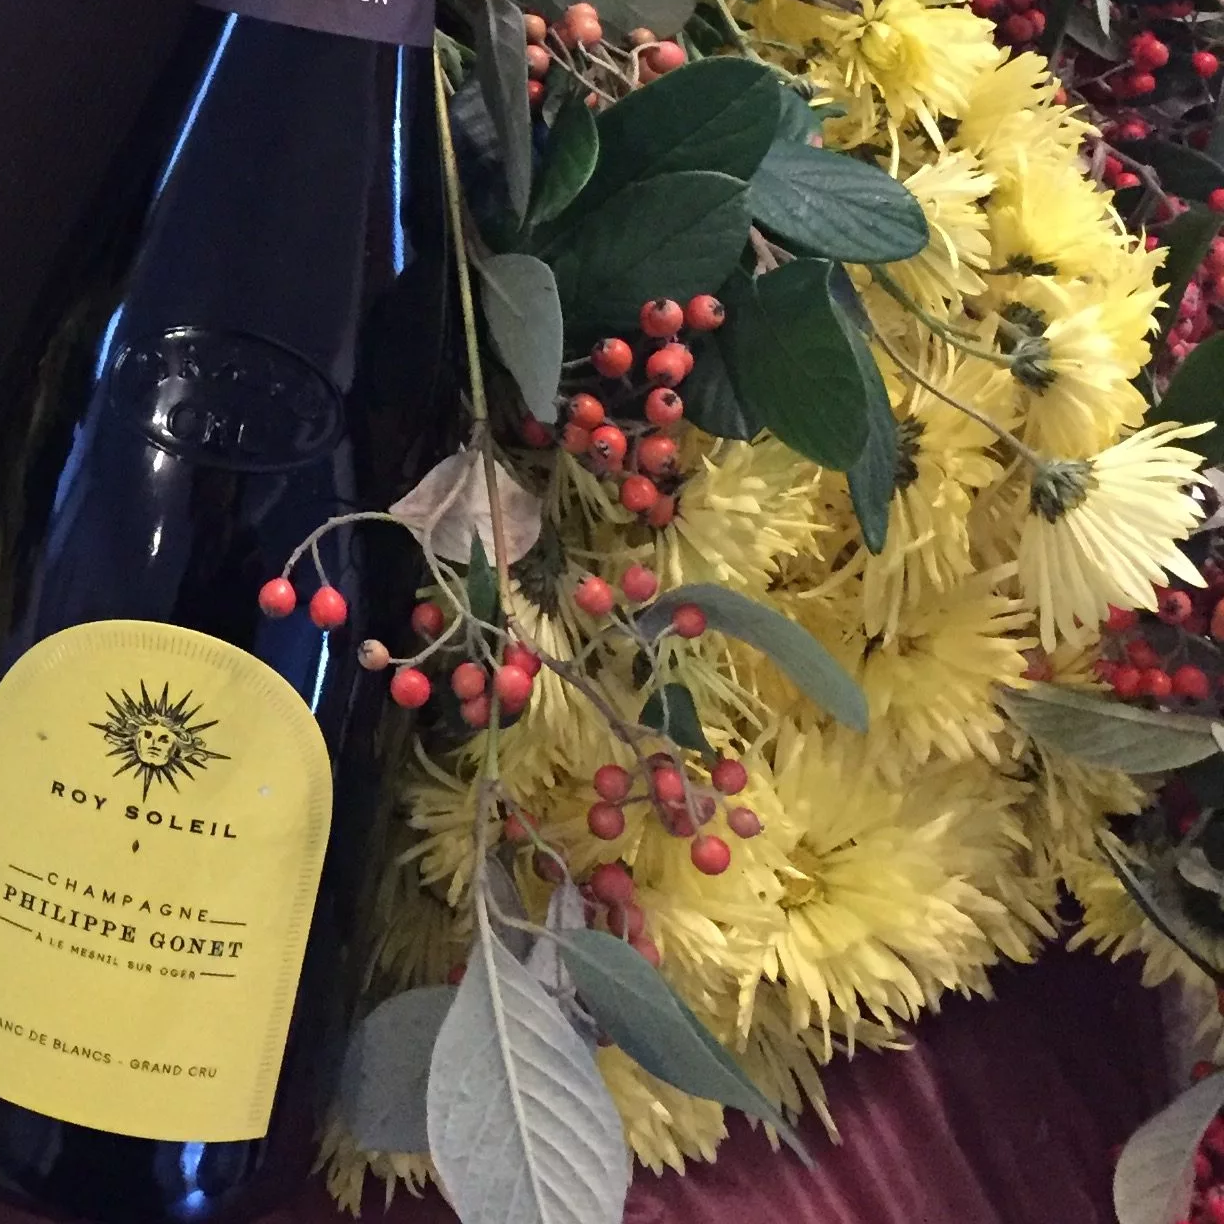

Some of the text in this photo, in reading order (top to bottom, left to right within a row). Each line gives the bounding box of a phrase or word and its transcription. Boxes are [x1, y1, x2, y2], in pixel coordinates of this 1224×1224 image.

[51, 780, 237, 839] ROY SOLEIL
[3, 883, 243, 958] PHILIPPE GONET
[47, 872, 209, 922] CHAMPAGNE
[49, 937, 64, 950] LE
[71, 944, 119, 966] MESNIL
[127, 960, 152, 973] SUR
[160, 967, 196, 980] OGER
[28, 1029, 48, 1046] DE
[53, 1038, 112, 1064] BLANCS
[130, 1058, 183, 1076] GRAND
[188, 1066, 218, 1078] CRU
